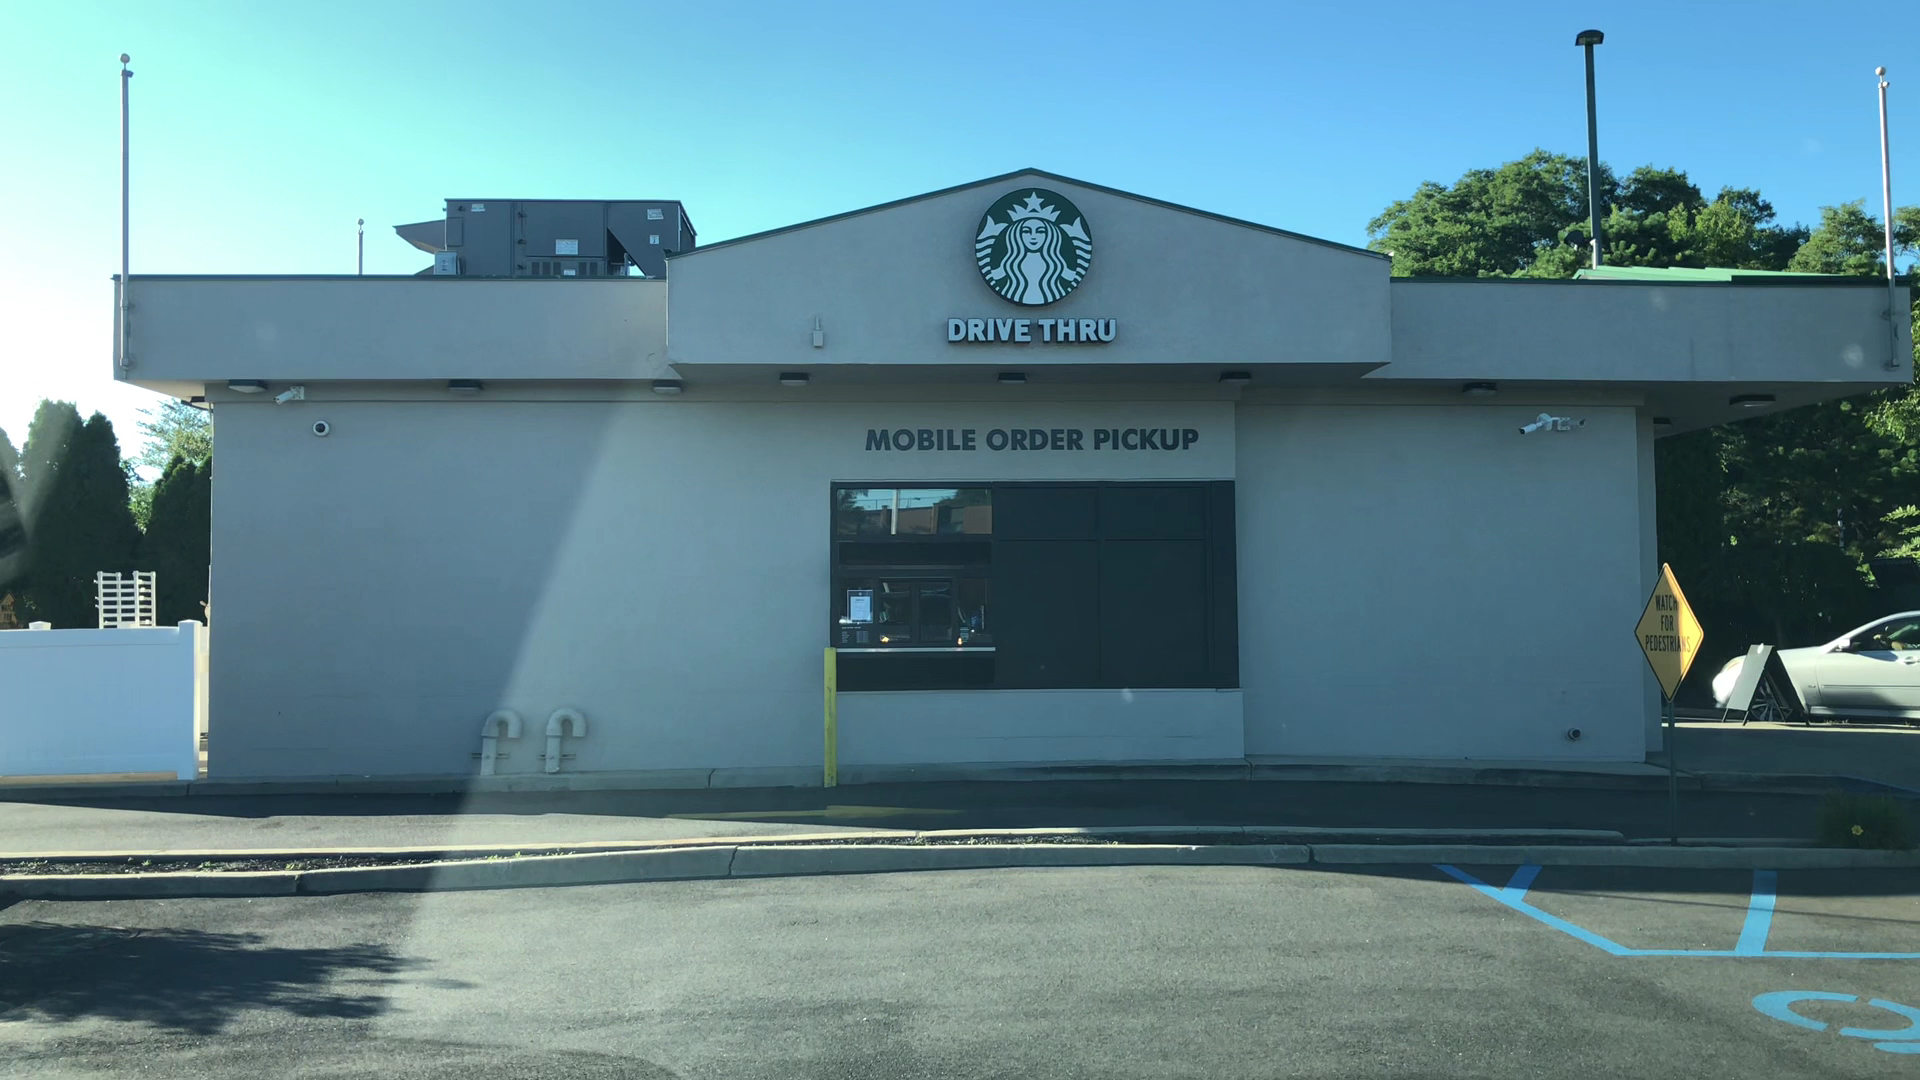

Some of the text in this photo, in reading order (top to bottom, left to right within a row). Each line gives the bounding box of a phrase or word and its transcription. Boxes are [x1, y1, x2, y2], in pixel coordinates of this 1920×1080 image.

[948, 318, 1117, 342] DRIVE THRU
[865, 428, 1199, 451] MOBILE ORDER PICKUP
[1655, 595, 1678, 612] WATCH
[1660, 615, 1674, 631] FOR
[1645, 634, 1691, 652] PEDESTRIANS
